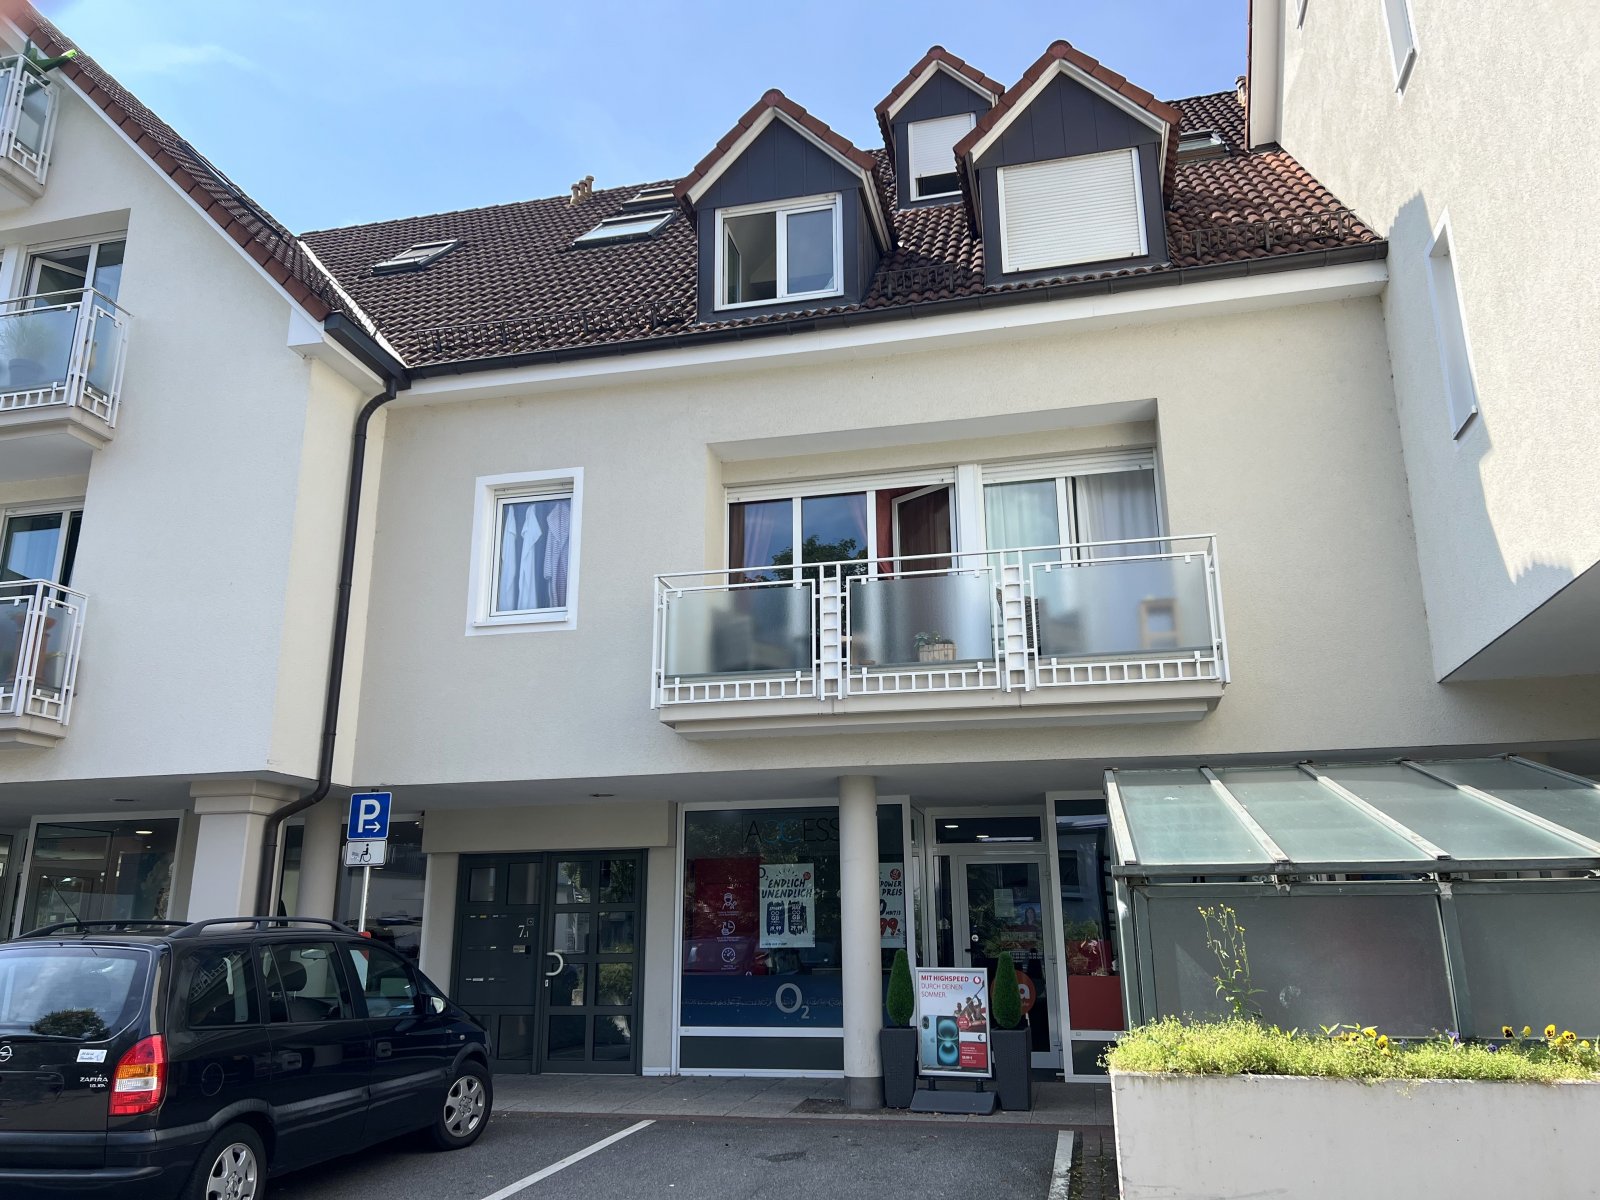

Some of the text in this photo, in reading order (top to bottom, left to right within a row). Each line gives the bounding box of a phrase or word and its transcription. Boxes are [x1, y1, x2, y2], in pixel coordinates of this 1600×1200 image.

[357, 799, 380, 833] P
[768, 878, 806, 888] ENDLICH
[880, 880, 902, 888] POWER
[761, 888, 813, 899] UNENDLICH
[882, 888, 903, 896] PREIS
[933, 975, 970, 983] HIGHSPEED
